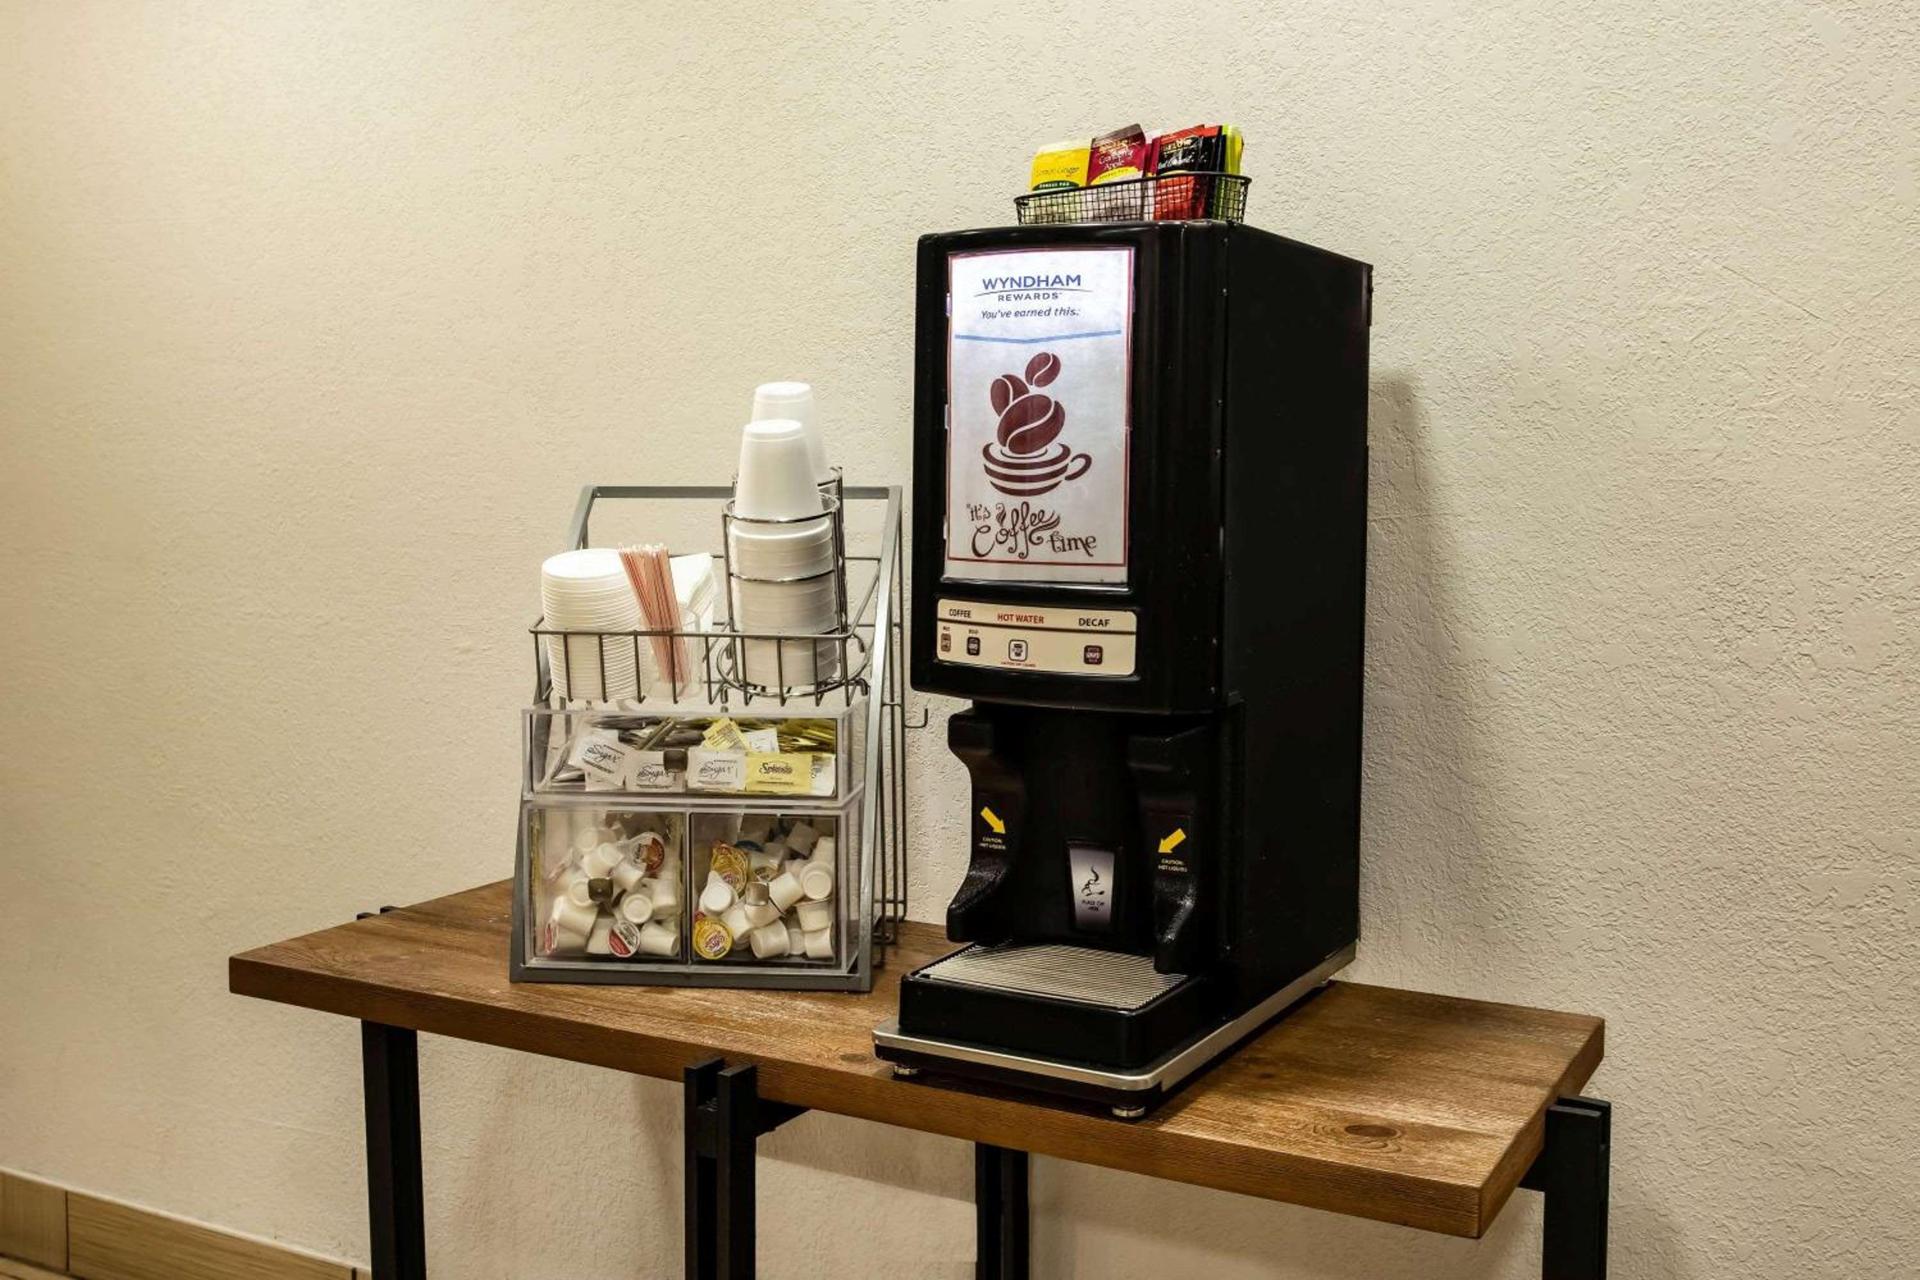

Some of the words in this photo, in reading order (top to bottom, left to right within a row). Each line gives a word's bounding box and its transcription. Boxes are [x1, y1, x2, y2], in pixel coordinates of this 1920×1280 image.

[982, 274, 1082, 290] WYNDHAM
[997, 292, 1059, 302] REWARDS
[981, 308, 1012, 319] You've
[1013, 307, 1051, 318] earned
[1054, 306, 1079, 317] this.
[971, 501, 1061, 559] Coffee
[1046, 530, 1097, 557] time
[949, 608, 972, 618] COFFEE
[997, 612, 1014, 622] HOT
[1015, 614, 1045, 624] WATER
[1078, 617, 1111, 628] DECAF
